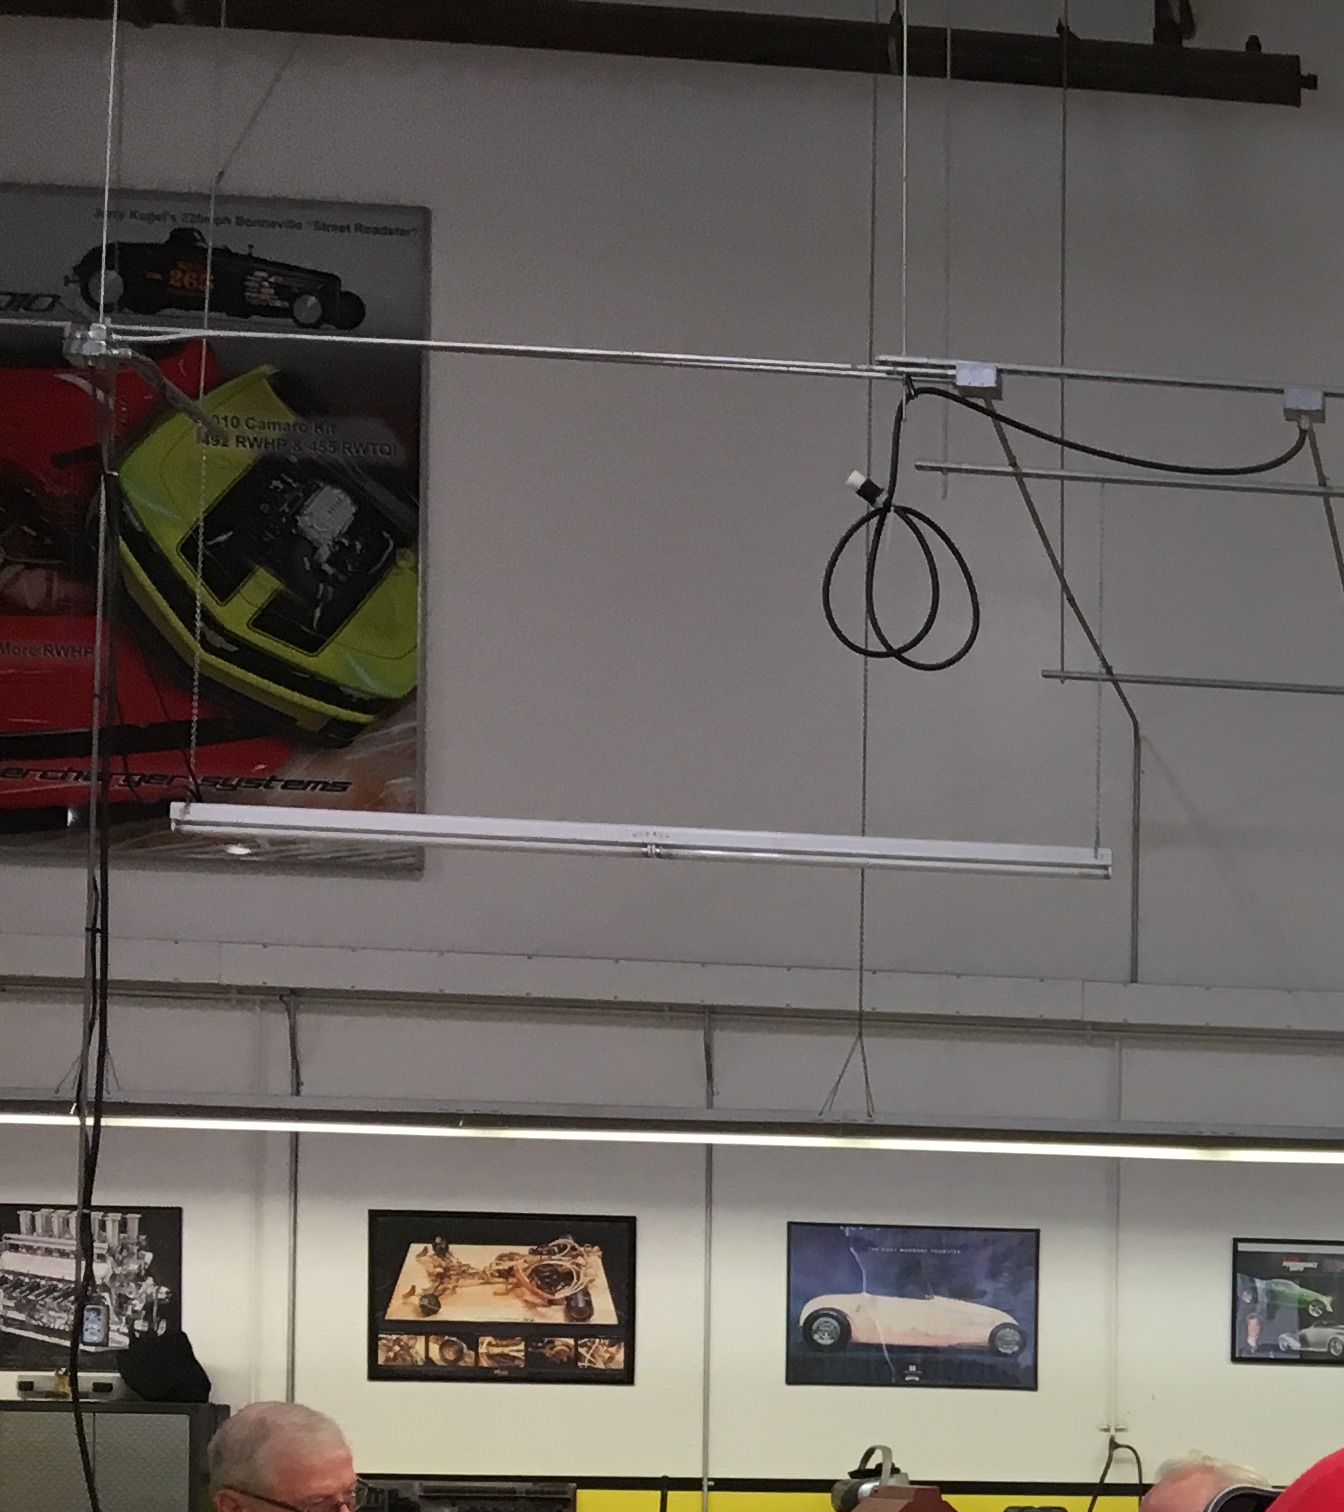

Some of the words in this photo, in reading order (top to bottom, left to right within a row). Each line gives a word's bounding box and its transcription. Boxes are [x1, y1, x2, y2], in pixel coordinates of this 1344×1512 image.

[245, 416, 307, 434] Camaro
[235, 434, 288, 450] RWHP
[200, 774, 351, 793] systems
